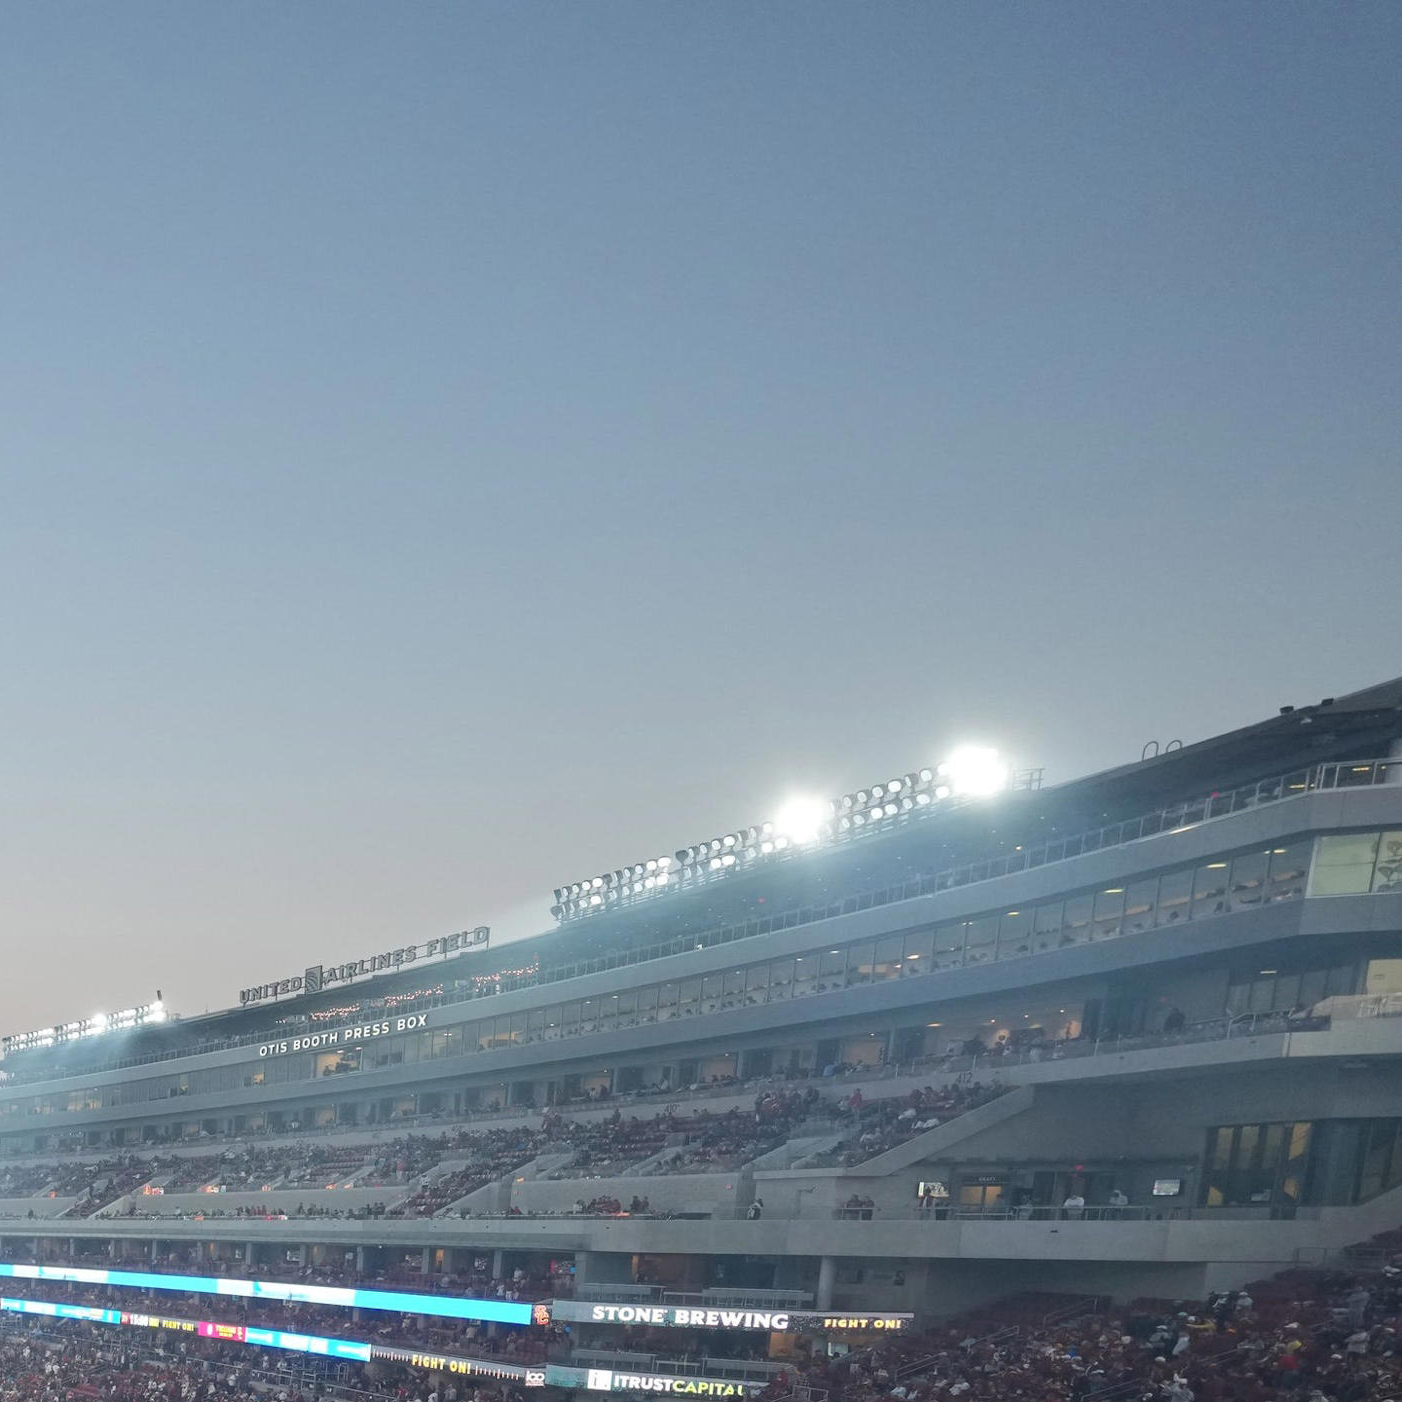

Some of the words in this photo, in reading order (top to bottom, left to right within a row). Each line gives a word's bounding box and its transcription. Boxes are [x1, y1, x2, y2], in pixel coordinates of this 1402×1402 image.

[239, 977, 302, 1004] UNITED
[326, 946, 416, 983] AIRLINES
[427, 926, 490, 957] FIELD
[259, 1039, 287, 1057] OTIS
[293, 1033, 339, 1051] BOOTH
[345, 1023, 390, 1041] PRESS
[397, 1014, 428, 1031] BOX
[592, 1305, 664, 1323] STONE
[675, 1310, 789, 1329] BREWING
[824, 1318, 869, 1328] FIGHT
[873, 1319, 902, 1329] ON!
[411, 1354, 446, 1370] FIGHT
[449, 1360, 471, 1375] ON!
[613, 1374, 744, 1397] ITRUSTCAPITAL
